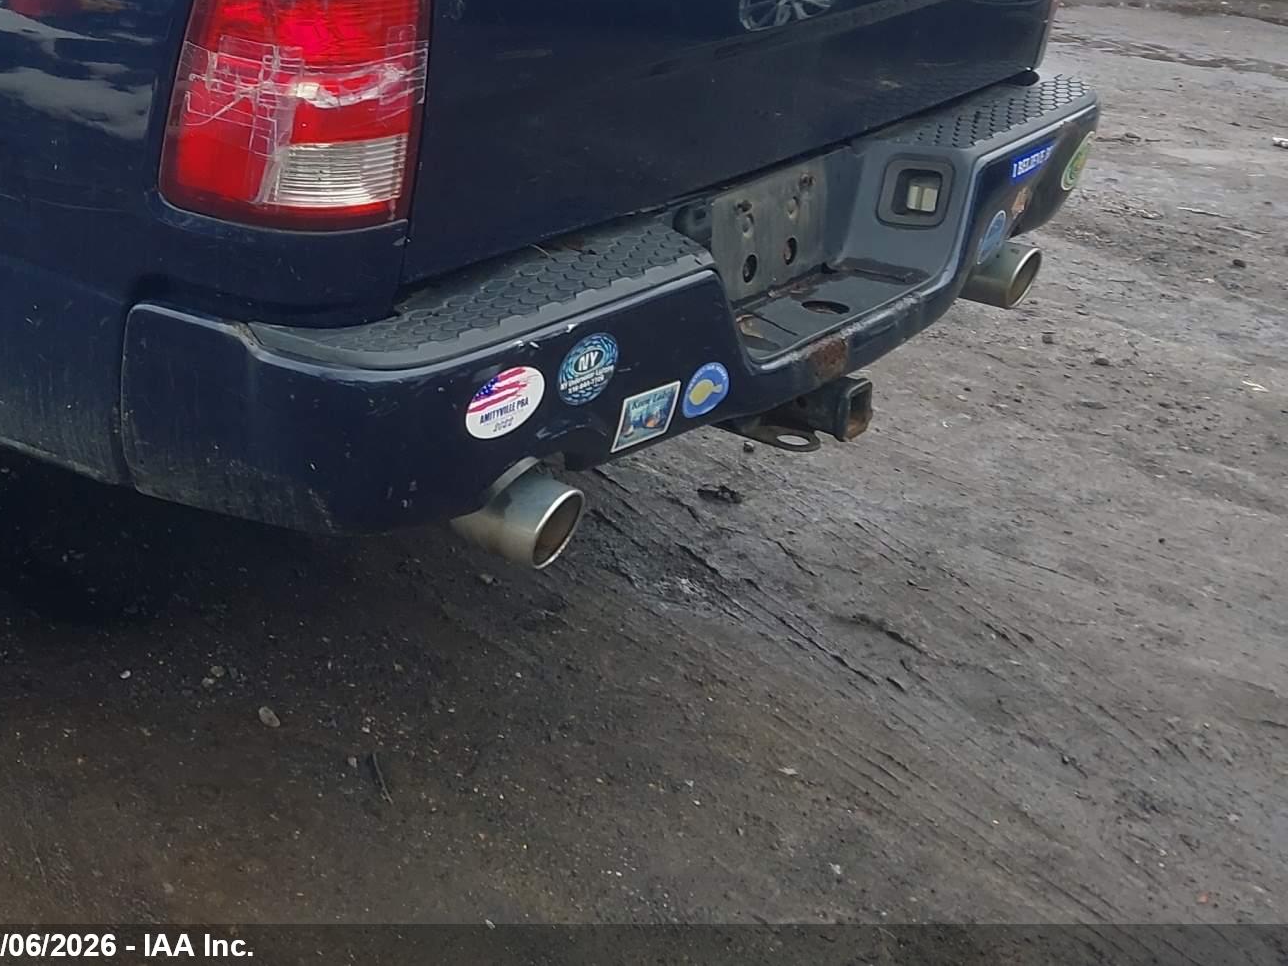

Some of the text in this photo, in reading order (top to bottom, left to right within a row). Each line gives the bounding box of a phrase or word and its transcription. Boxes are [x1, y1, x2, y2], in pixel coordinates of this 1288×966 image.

[578, 351, 599, 371] NY
[480, 397, 529, 425] AMITYVILLE PBA
